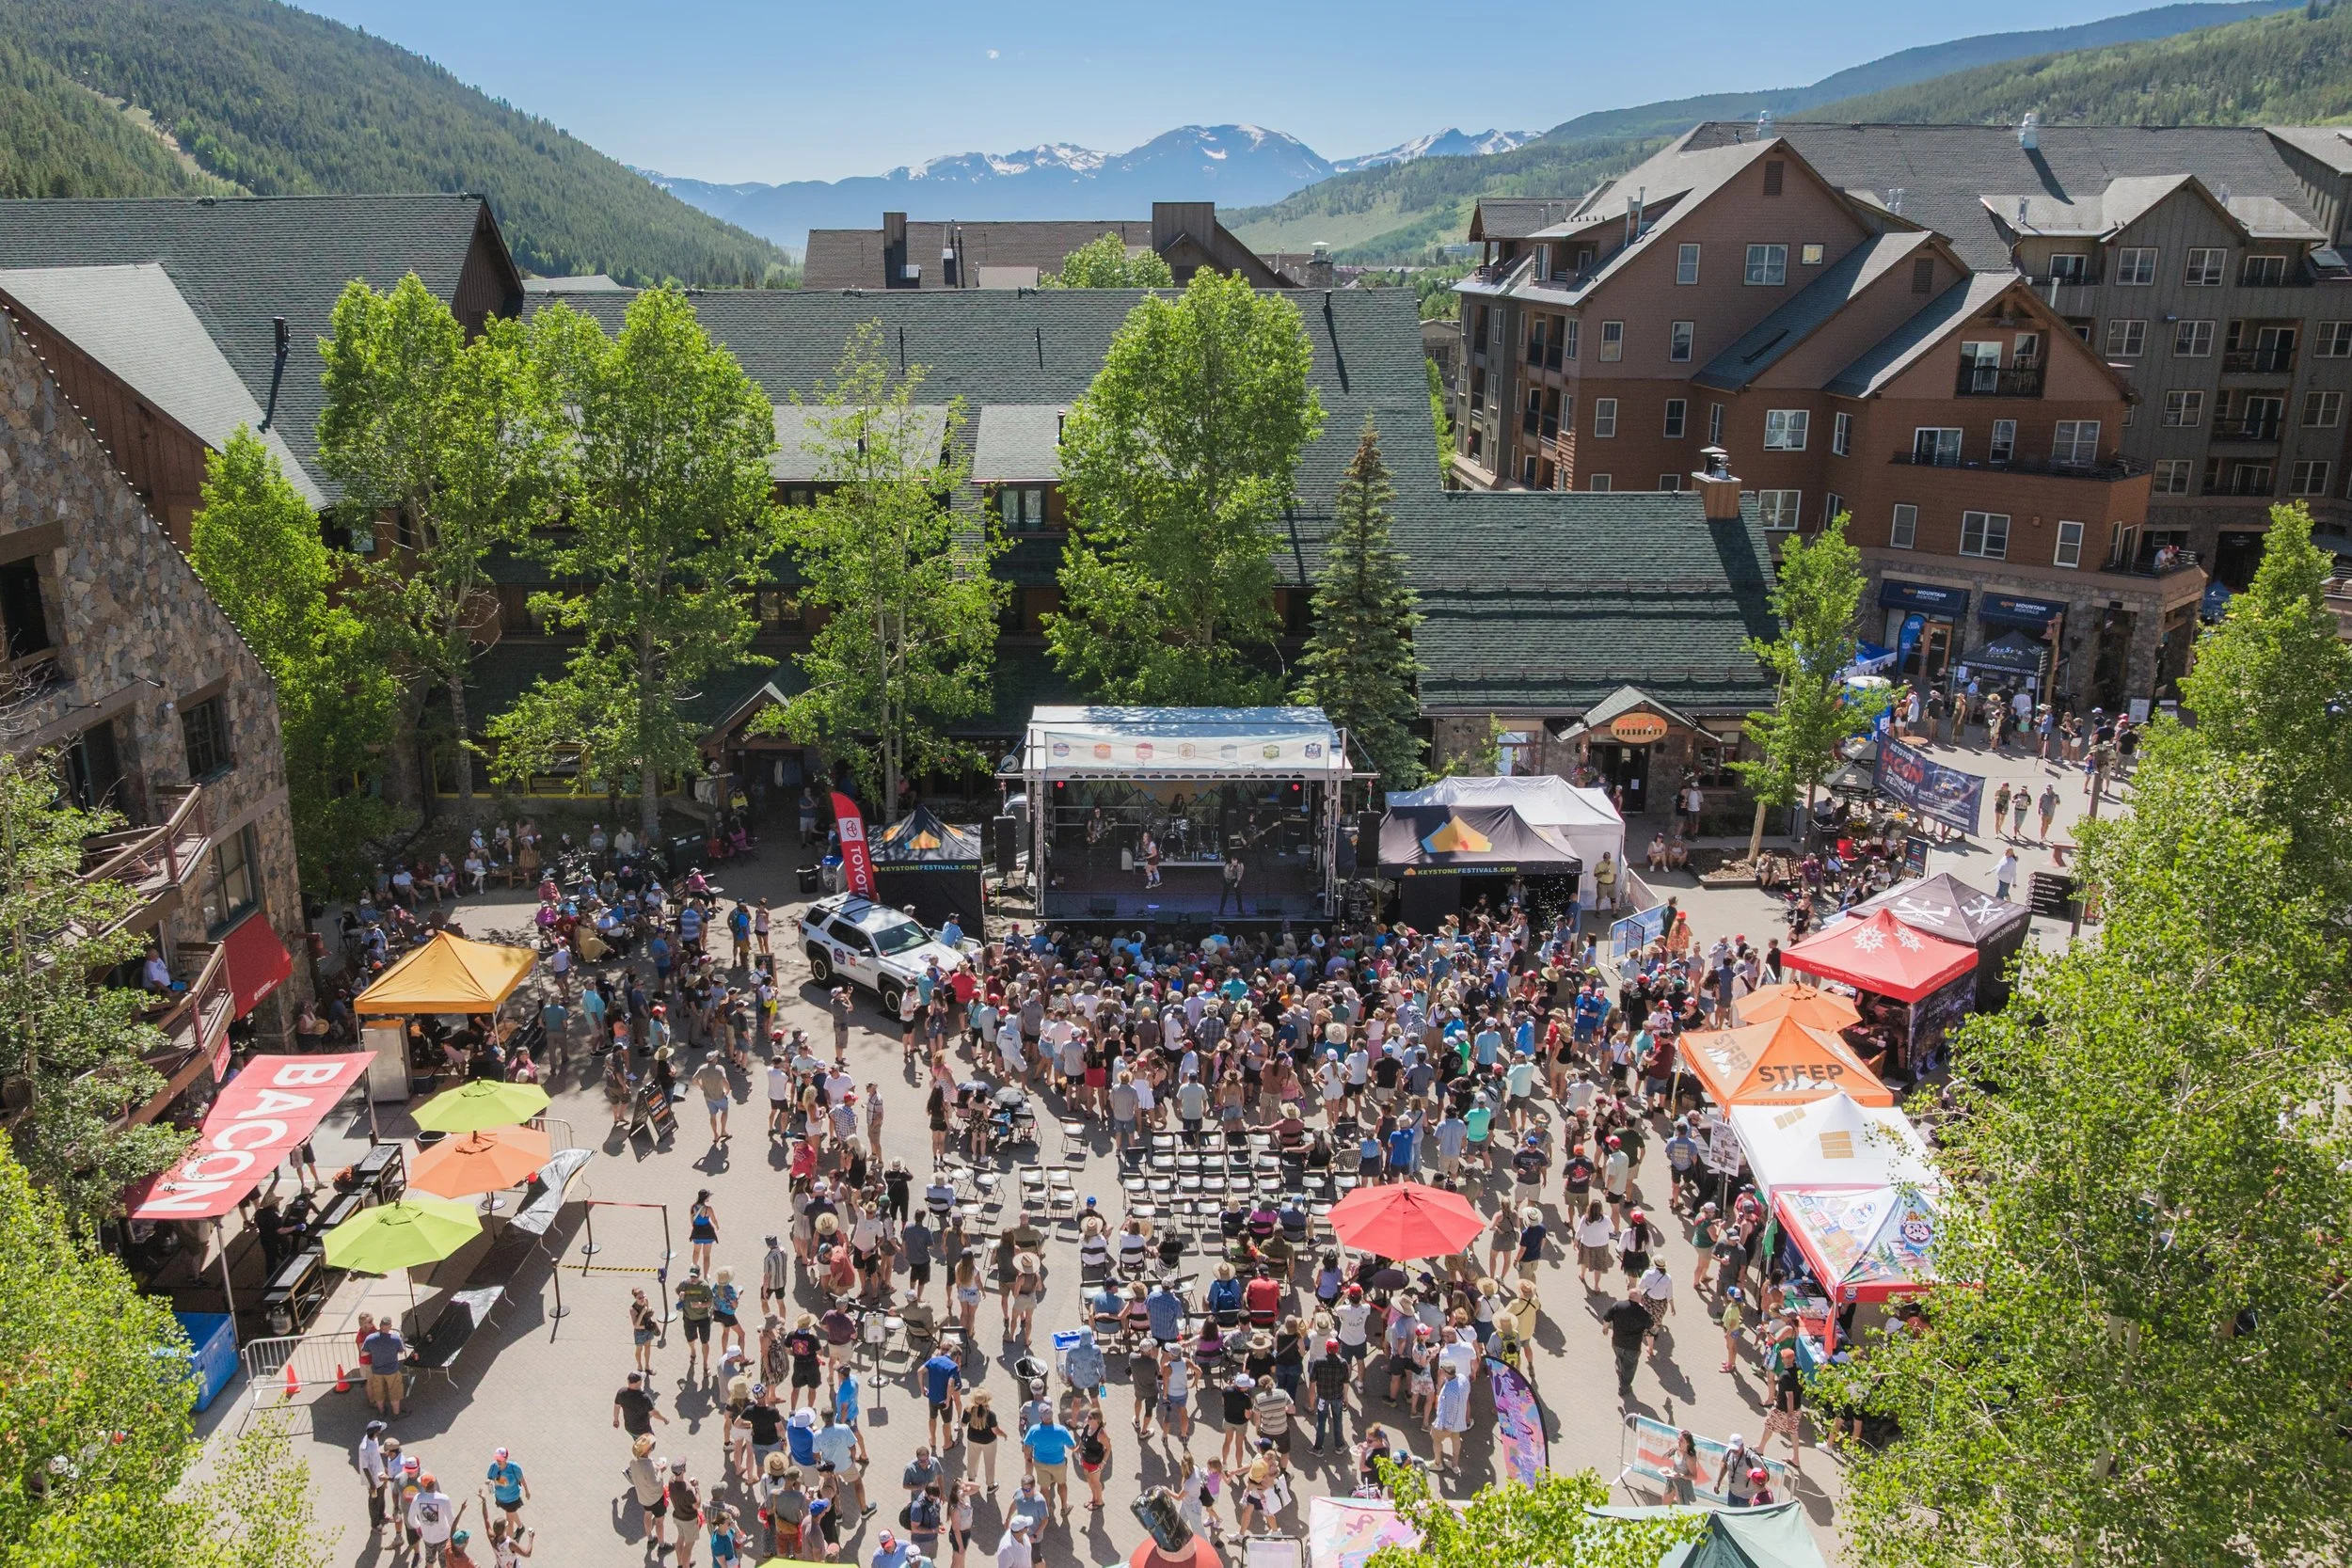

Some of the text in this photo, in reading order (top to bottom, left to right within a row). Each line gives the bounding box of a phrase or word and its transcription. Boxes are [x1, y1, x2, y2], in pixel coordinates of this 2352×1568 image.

[1917, 590, 1947, 598] MOUNTAIN
[2015, 603, 2047, 611] MOUNTAIN
[1418, 866, 1518, 875] KEYSTONEFESTIVALS.COM
[1713, 1033, 1753, 1071] STEEP
[1758, 1064, 1844, 1083] STEEP
[135, 1062, 346, 1212] BACON
